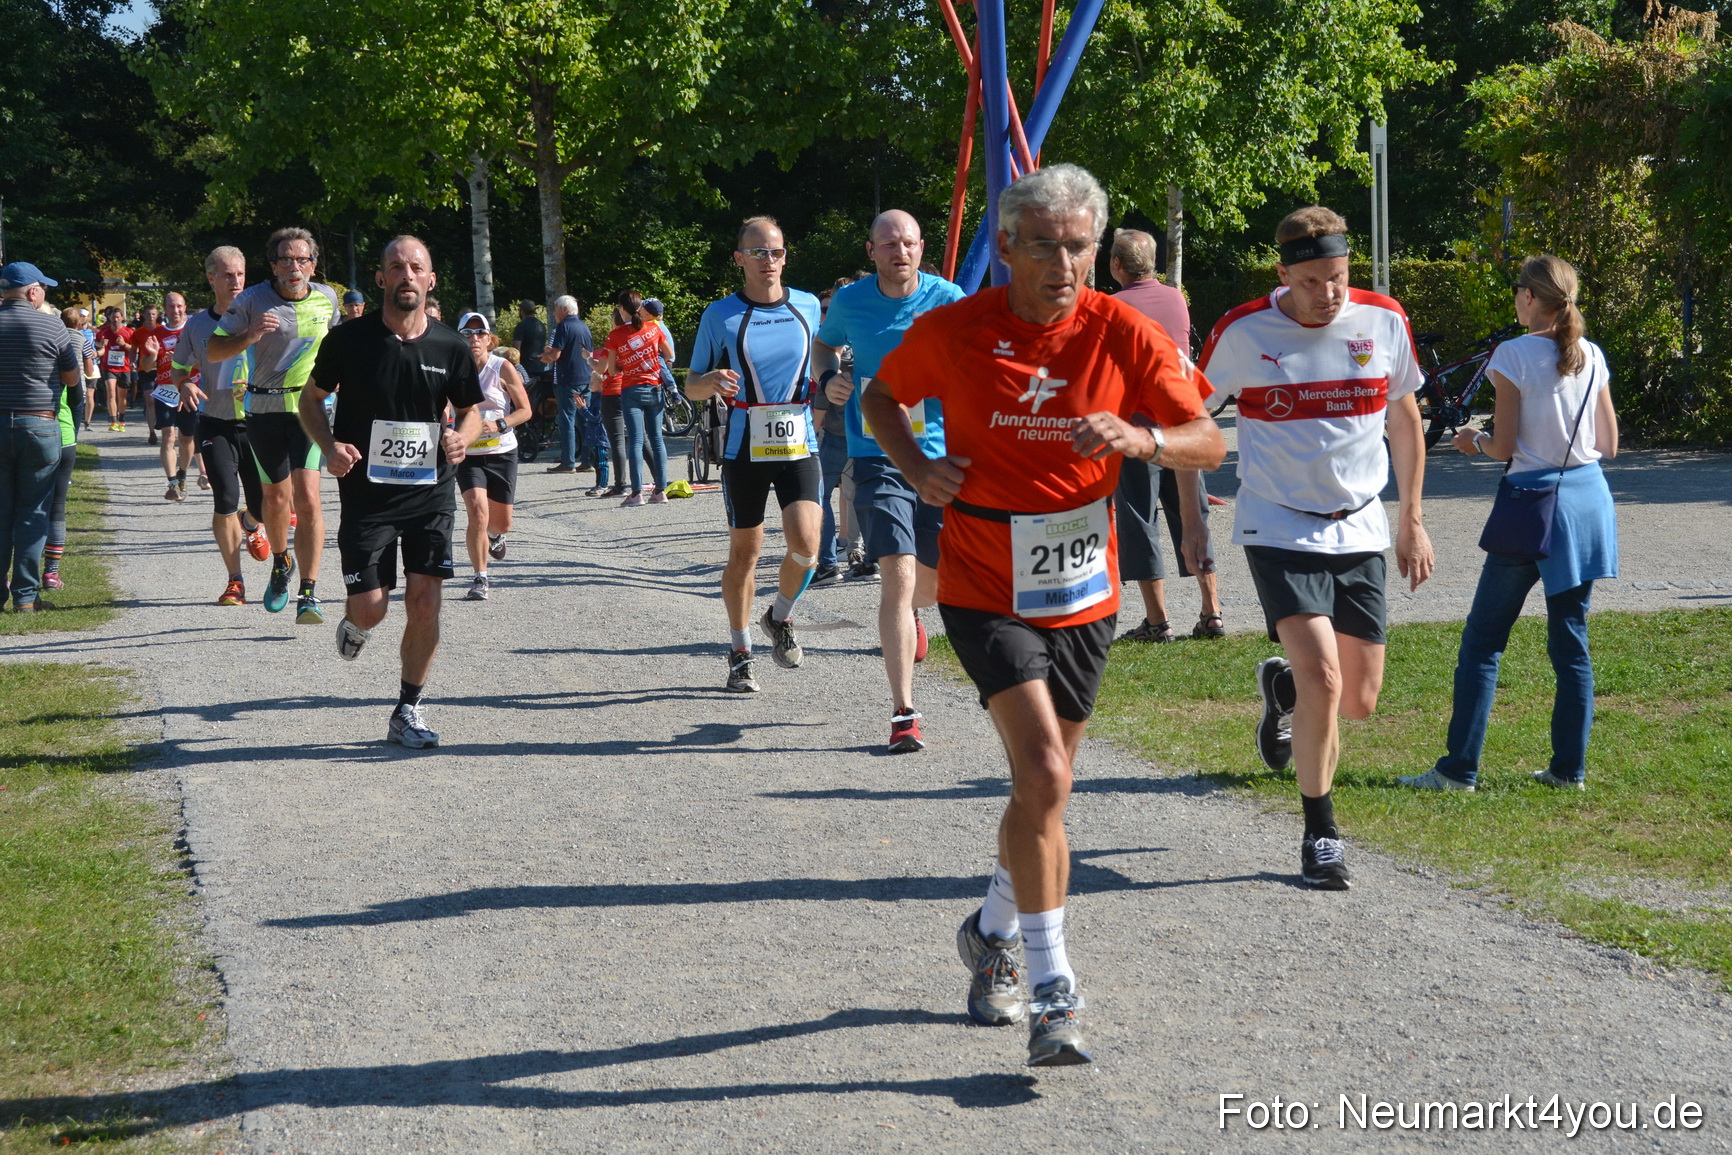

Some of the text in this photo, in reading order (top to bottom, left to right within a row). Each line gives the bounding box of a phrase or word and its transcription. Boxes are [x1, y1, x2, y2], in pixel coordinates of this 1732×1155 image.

[993, 348, 1015, 357] erima
[158, 387, 179, 400] 2227
[1298, 386, 1379, 401] Mercedes-Benz
[1326, 401, 1355, 412] Bank
[989, 410, 1076, 429] funrunner
[764, 420, 795, 438] 160
[1017, 428, 1076, 442] neuma
[380, 438, 428, 459] 2354
[764, 447, 797, 456] Christian
[389, 468, 415, 478] Marco
[1045, 516, 1089, 536] BOCK
[1030, 532, 1100, 576] 2192
[1037, 578, 1061, 586] PARTL
[1044, 583, 1090, 605] Michael
